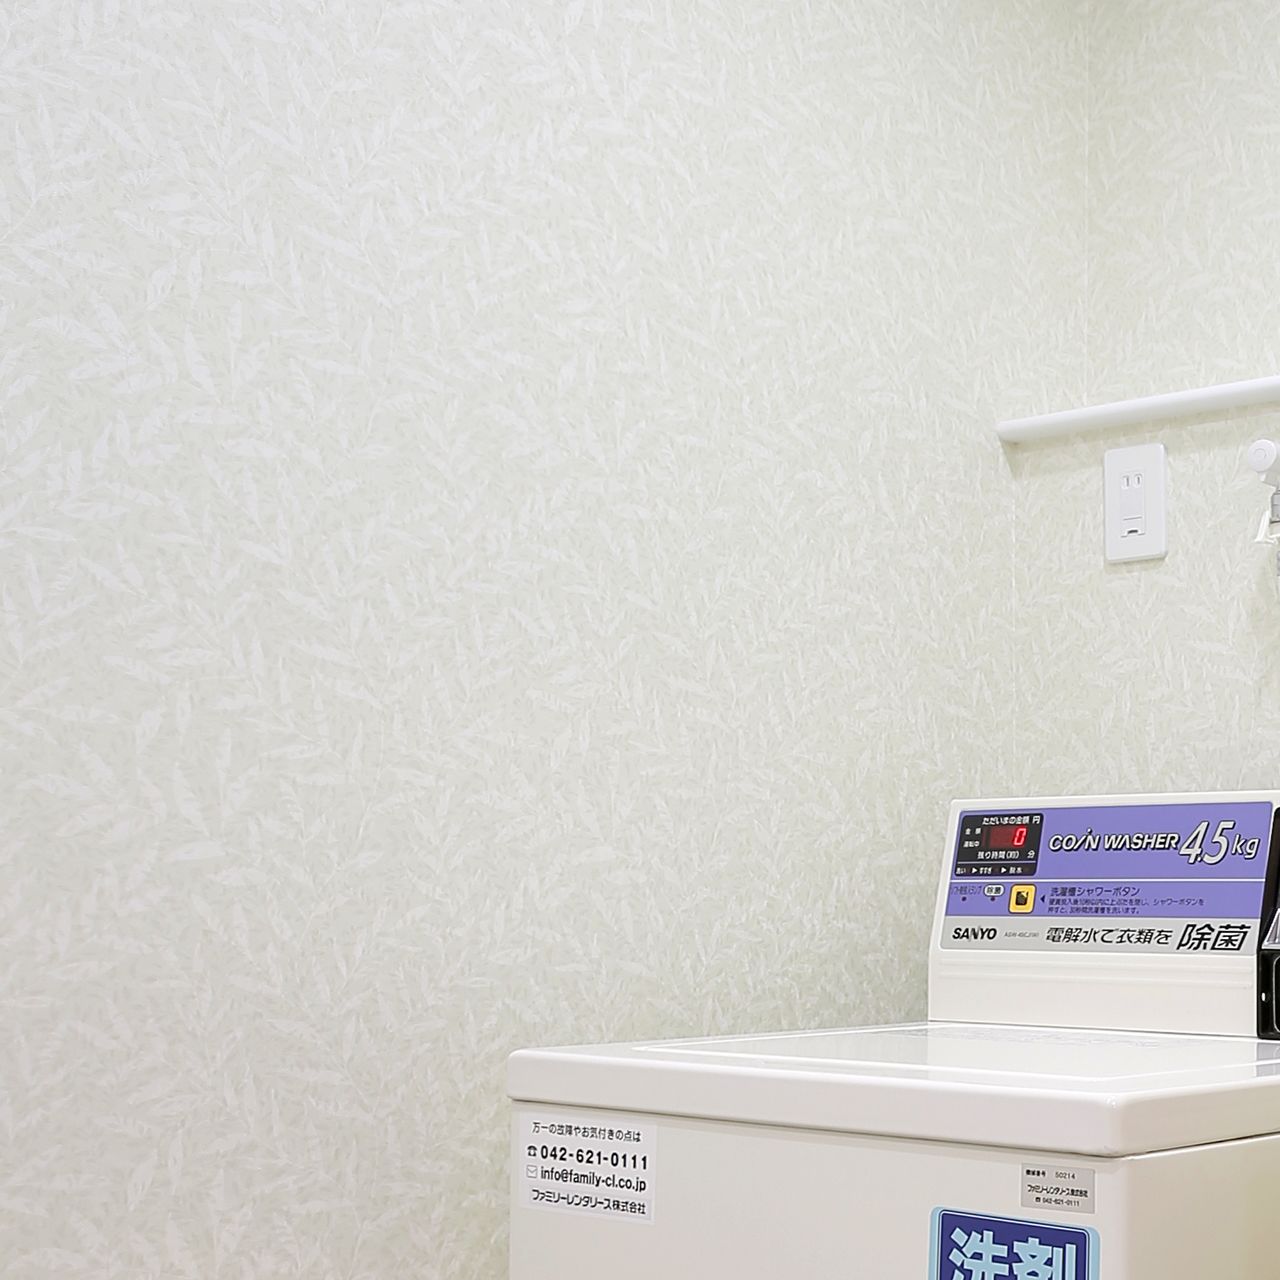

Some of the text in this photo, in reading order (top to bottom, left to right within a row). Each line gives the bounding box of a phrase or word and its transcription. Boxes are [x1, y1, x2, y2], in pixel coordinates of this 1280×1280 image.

[1013, 827, 1027, 846] 0
[1048, 827, 1100, 851] COIN
[1103, 832, 1180, 850] WASHER
[952, 926, 998, 941] SANYO
[1046, 923, 1251, 951] 電解水で衣類を 除菌
[532, 1121, 642, 1143] 万一の故障やお気付きの点は
[540, 1144, 648, 1171] 042-621-0111
[540, 1165, 647, 1193] info@family-cl.co.jp
[531, 1188, 647, 1216] ファミリーレンタリース株式会社
